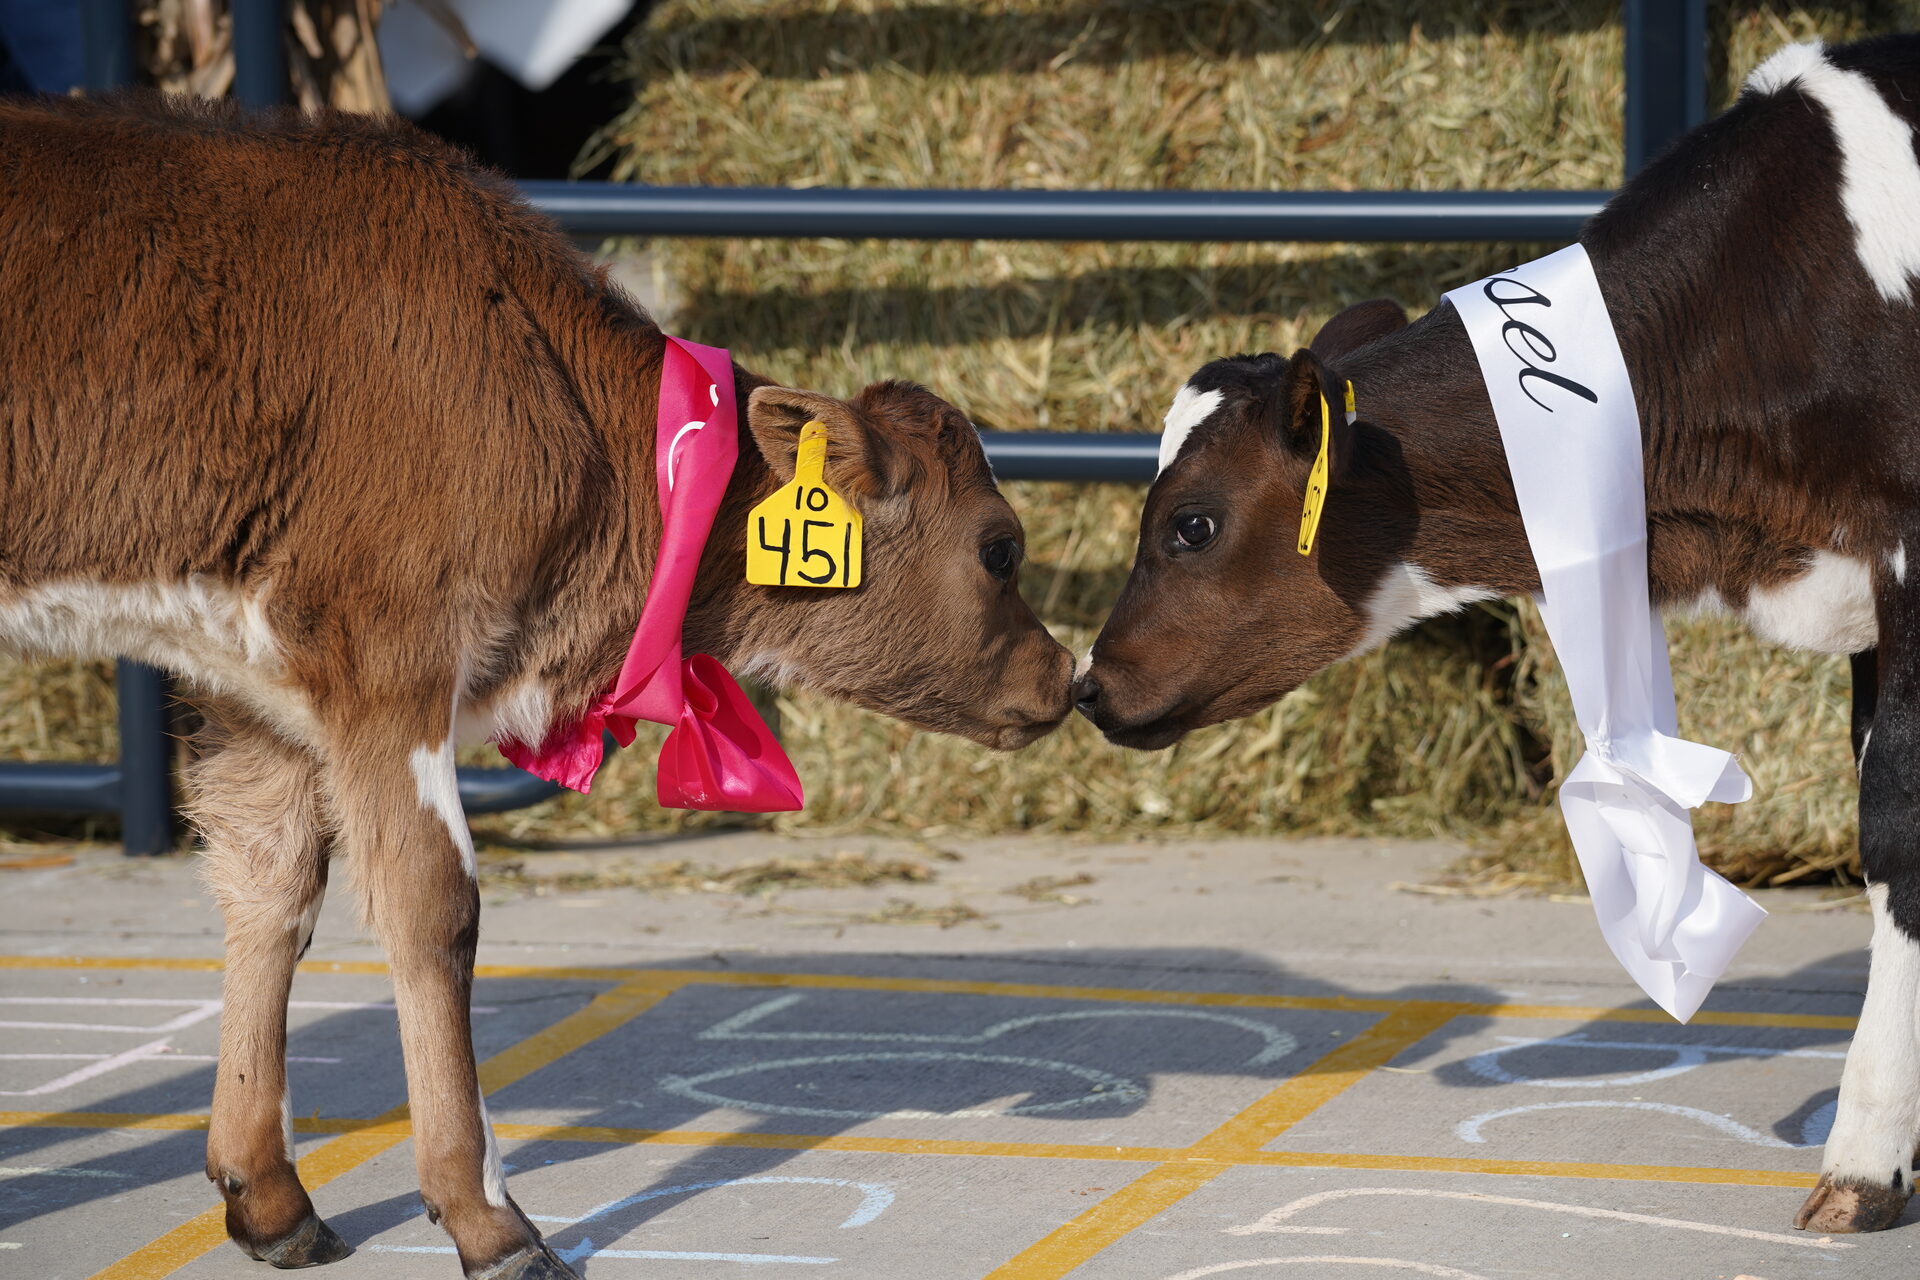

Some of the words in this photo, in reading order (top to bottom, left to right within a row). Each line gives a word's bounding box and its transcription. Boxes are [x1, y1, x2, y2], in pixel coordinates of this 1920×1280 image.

[1483, 267, 1598, 413] sel
[795, 485, 829, 511] 10
[759, 517, 851, 586] 451
